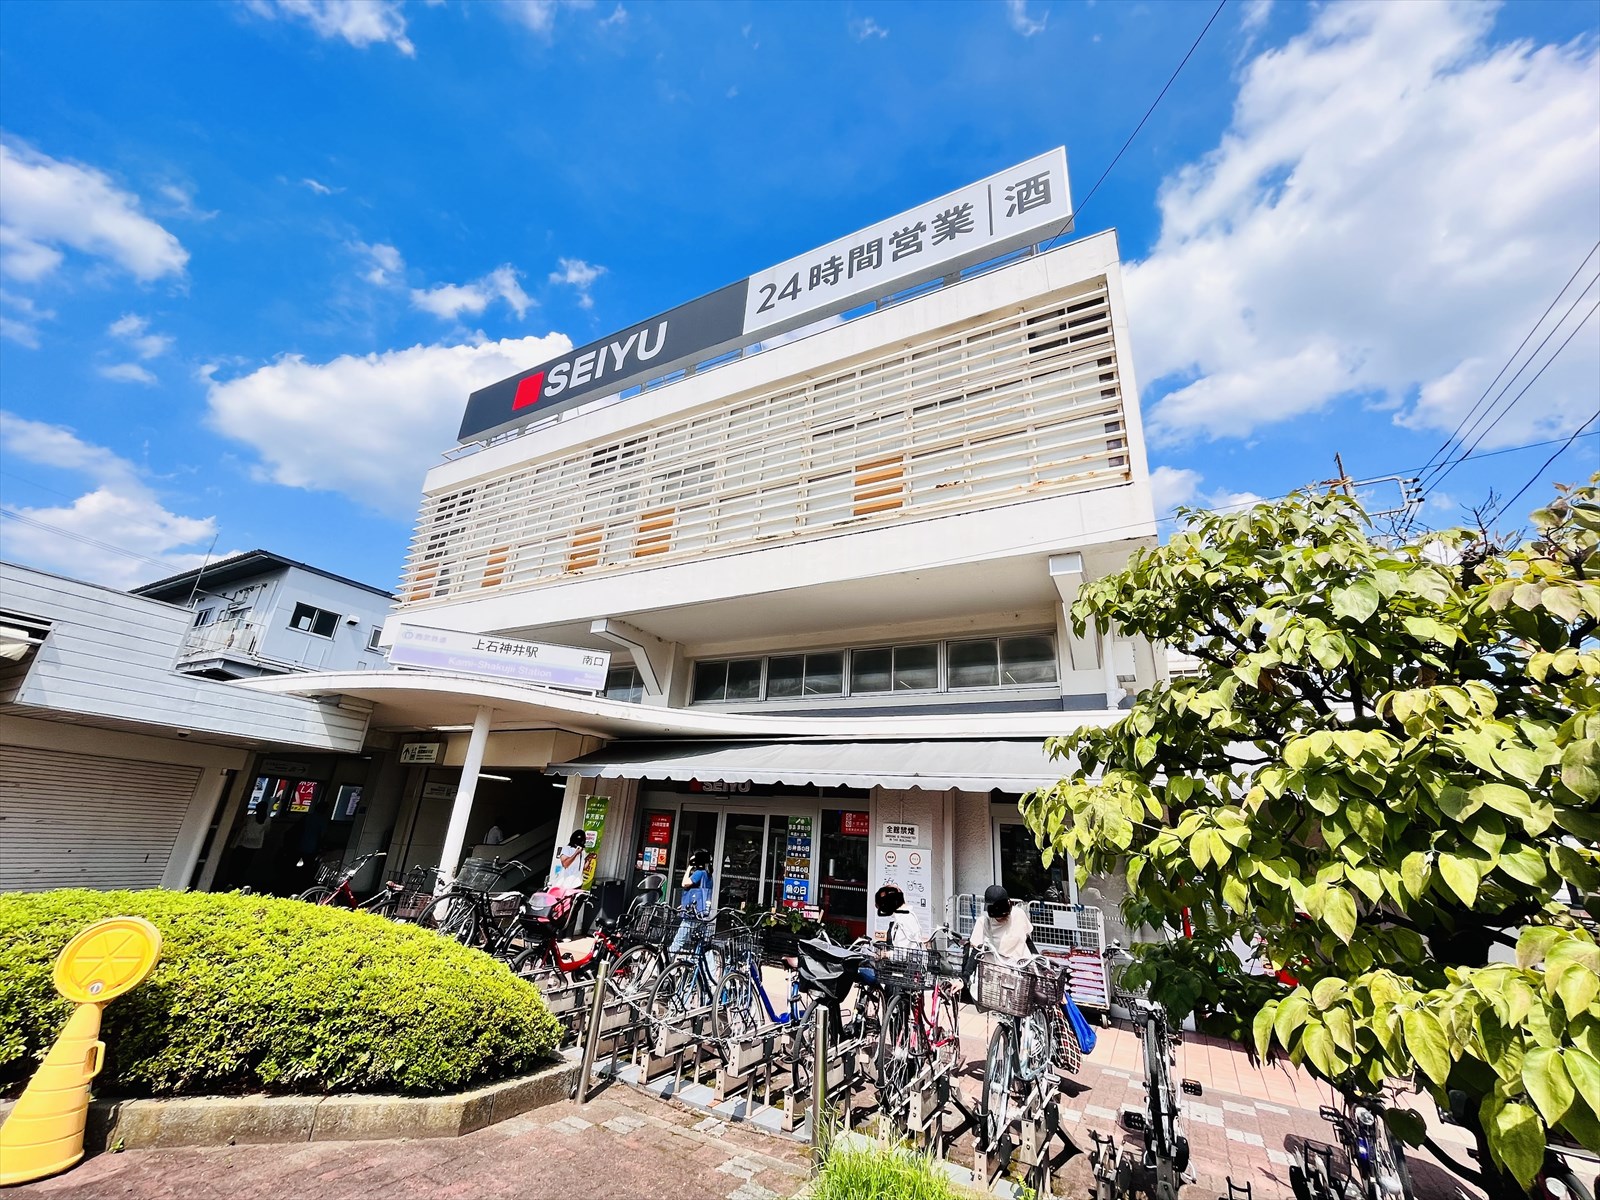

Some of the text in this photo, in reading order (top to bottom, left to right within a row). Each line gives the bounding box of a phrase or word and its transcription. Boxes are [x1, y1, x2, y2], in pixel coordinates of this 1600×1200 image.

[756, 170, 1053, 314] 24時間営業 酒
[543, 320, 669, 399] SEIYU
[472, 638, 604, 667] 上石神井駅 南口
[448, 656, 552, 678] Kami-Shakujii Station
[703, 781, 751, 793] SEIYU
[785, 884, 807, 895] 魚の日
